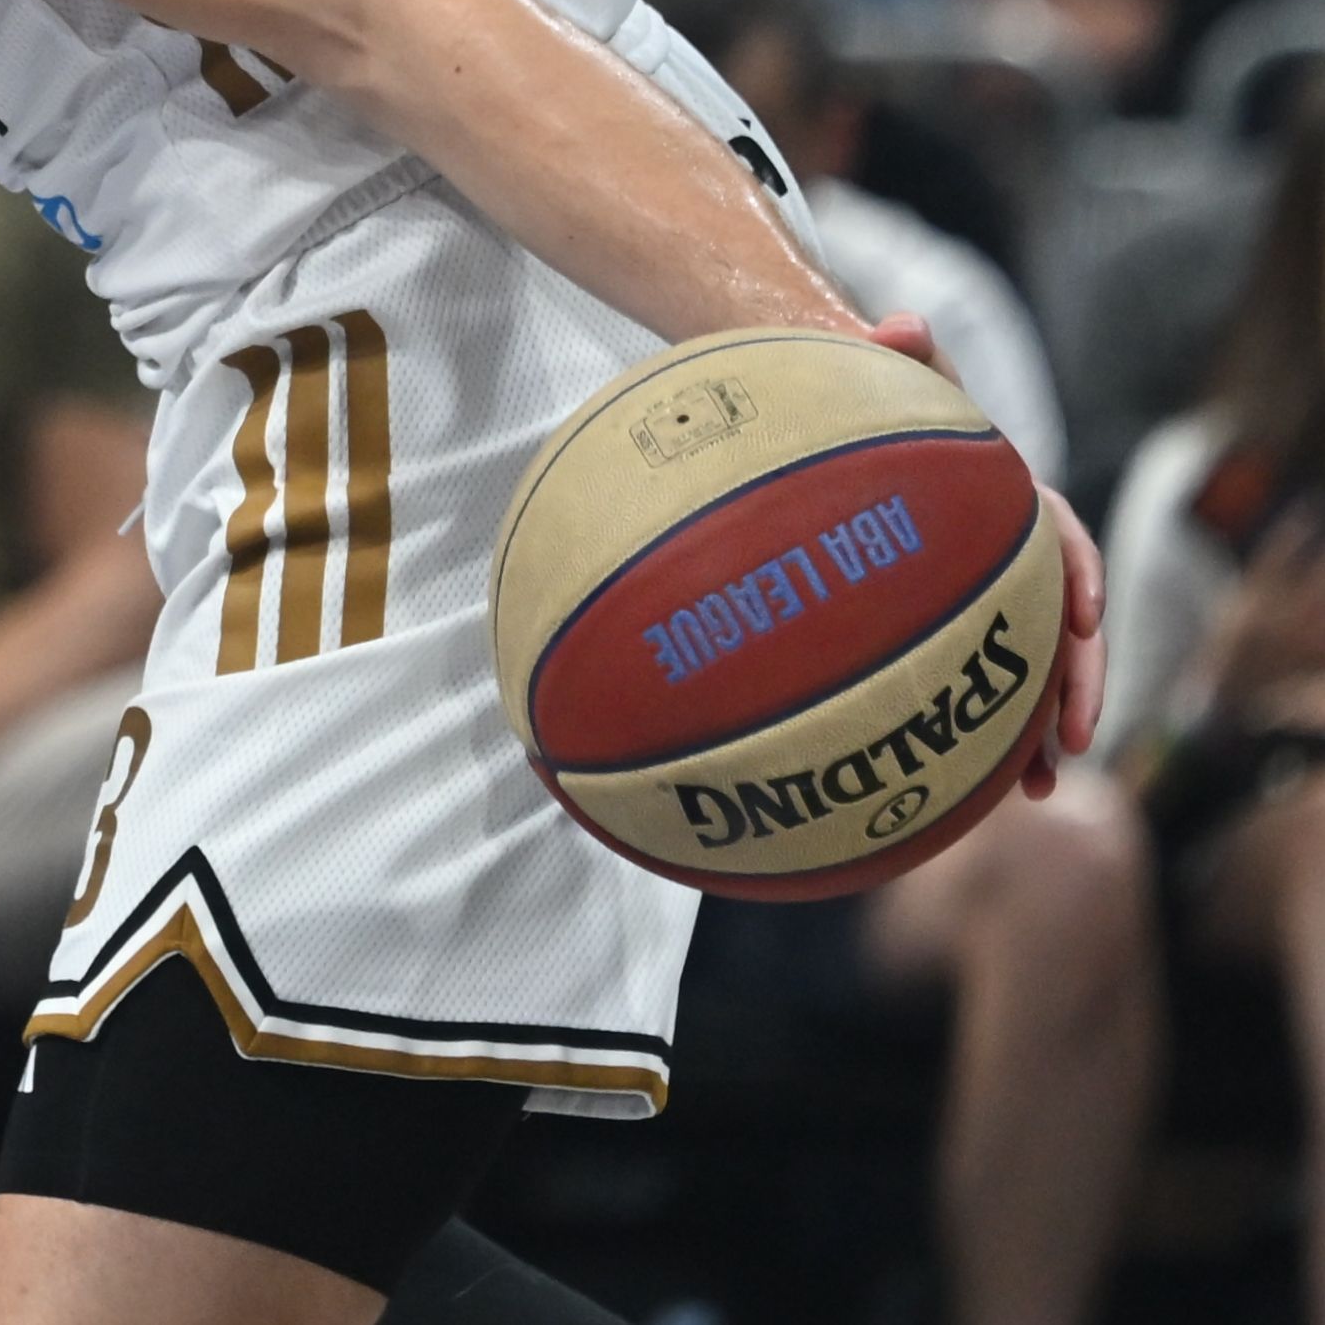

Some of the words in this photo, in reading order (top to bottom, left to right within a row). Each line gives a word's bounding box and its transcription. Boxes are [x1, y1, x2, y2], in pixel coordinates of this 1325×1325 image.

[817, 493, 925, 585] ABA
[642, 545, 831, 685] LEAGUE
[673, 610, 1030, 849] SPALDING
